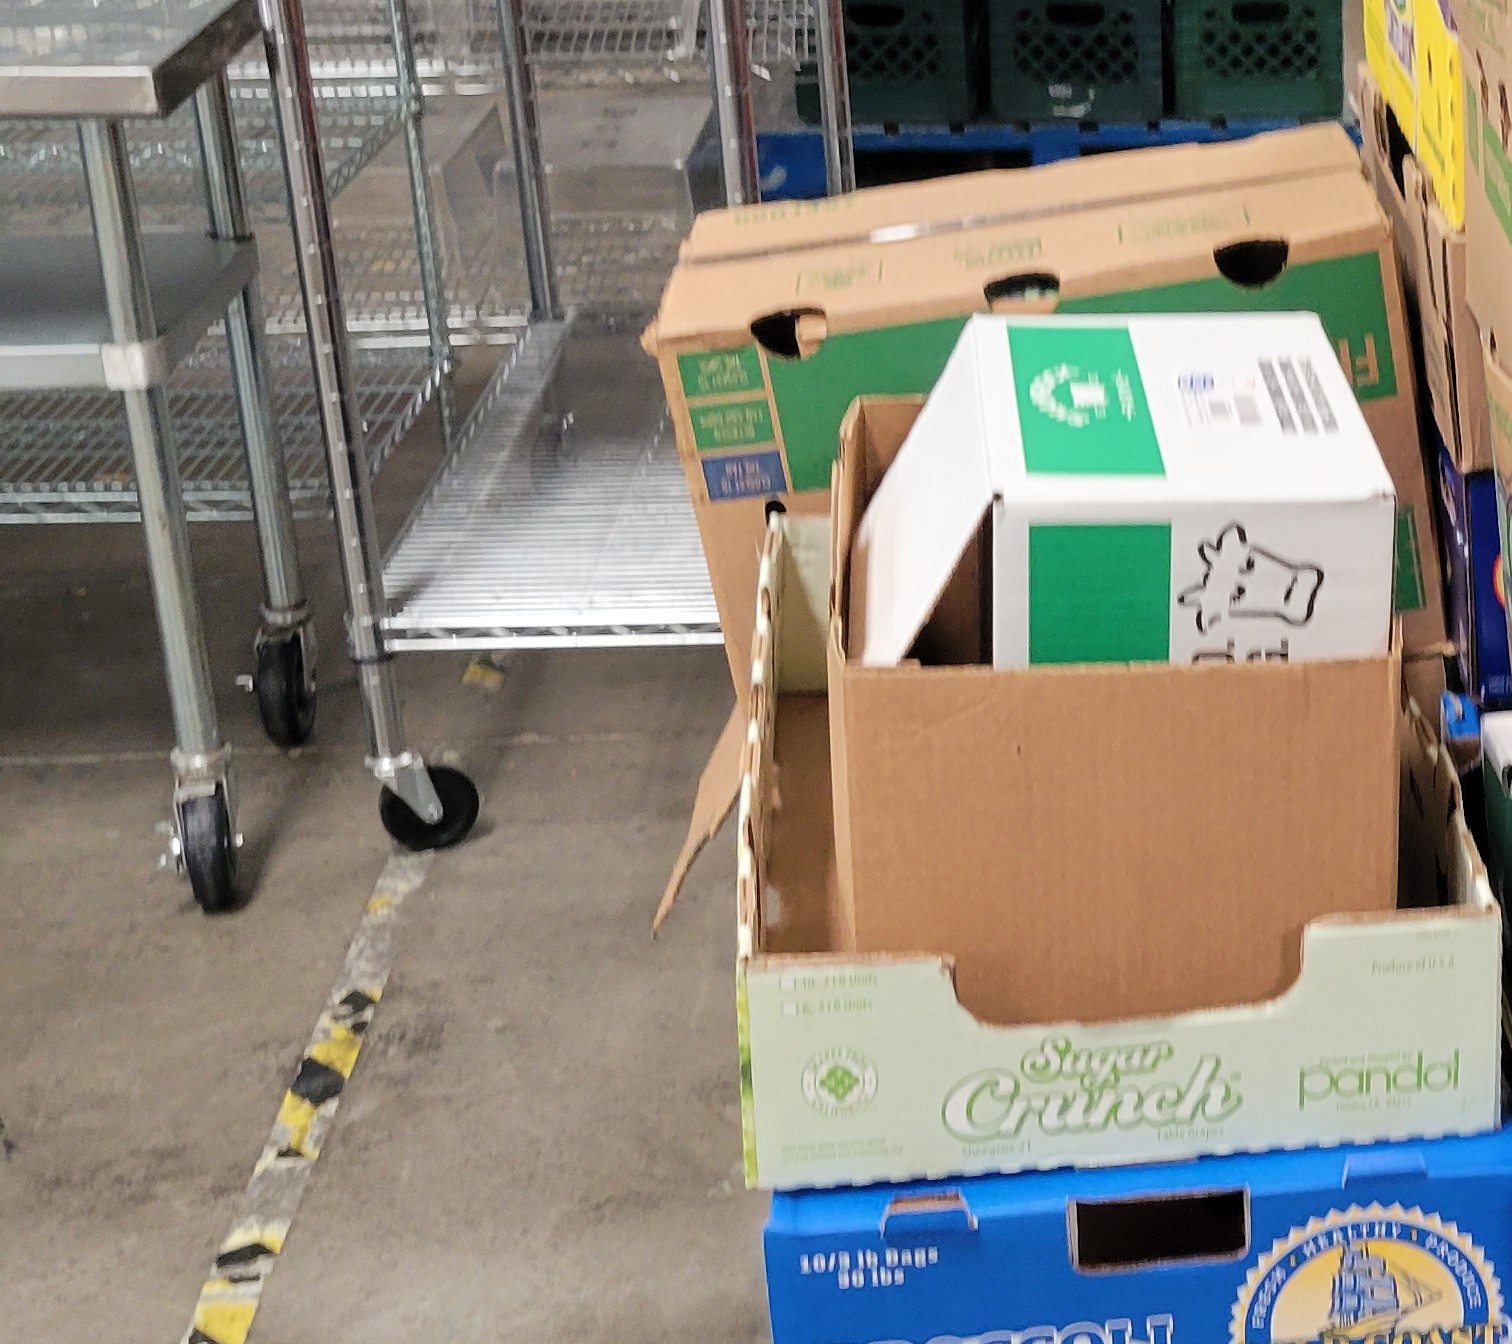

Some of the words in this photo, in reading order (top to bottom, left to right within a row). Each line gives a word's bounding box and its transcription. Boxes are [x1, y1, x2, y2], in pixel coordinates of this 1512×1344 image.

[1019, 1032, 1174, 1092] Sugar
[1299, 1046, 1460, 1112] pandol
[942, 1055, 1243, 1143] Crunch
[1302, 1220, 1402, 1259] HEALTHY
[1424, 1232, 1482, 1309] PRODUCE
[1251, 1265, 1287, 1330] FRESH
